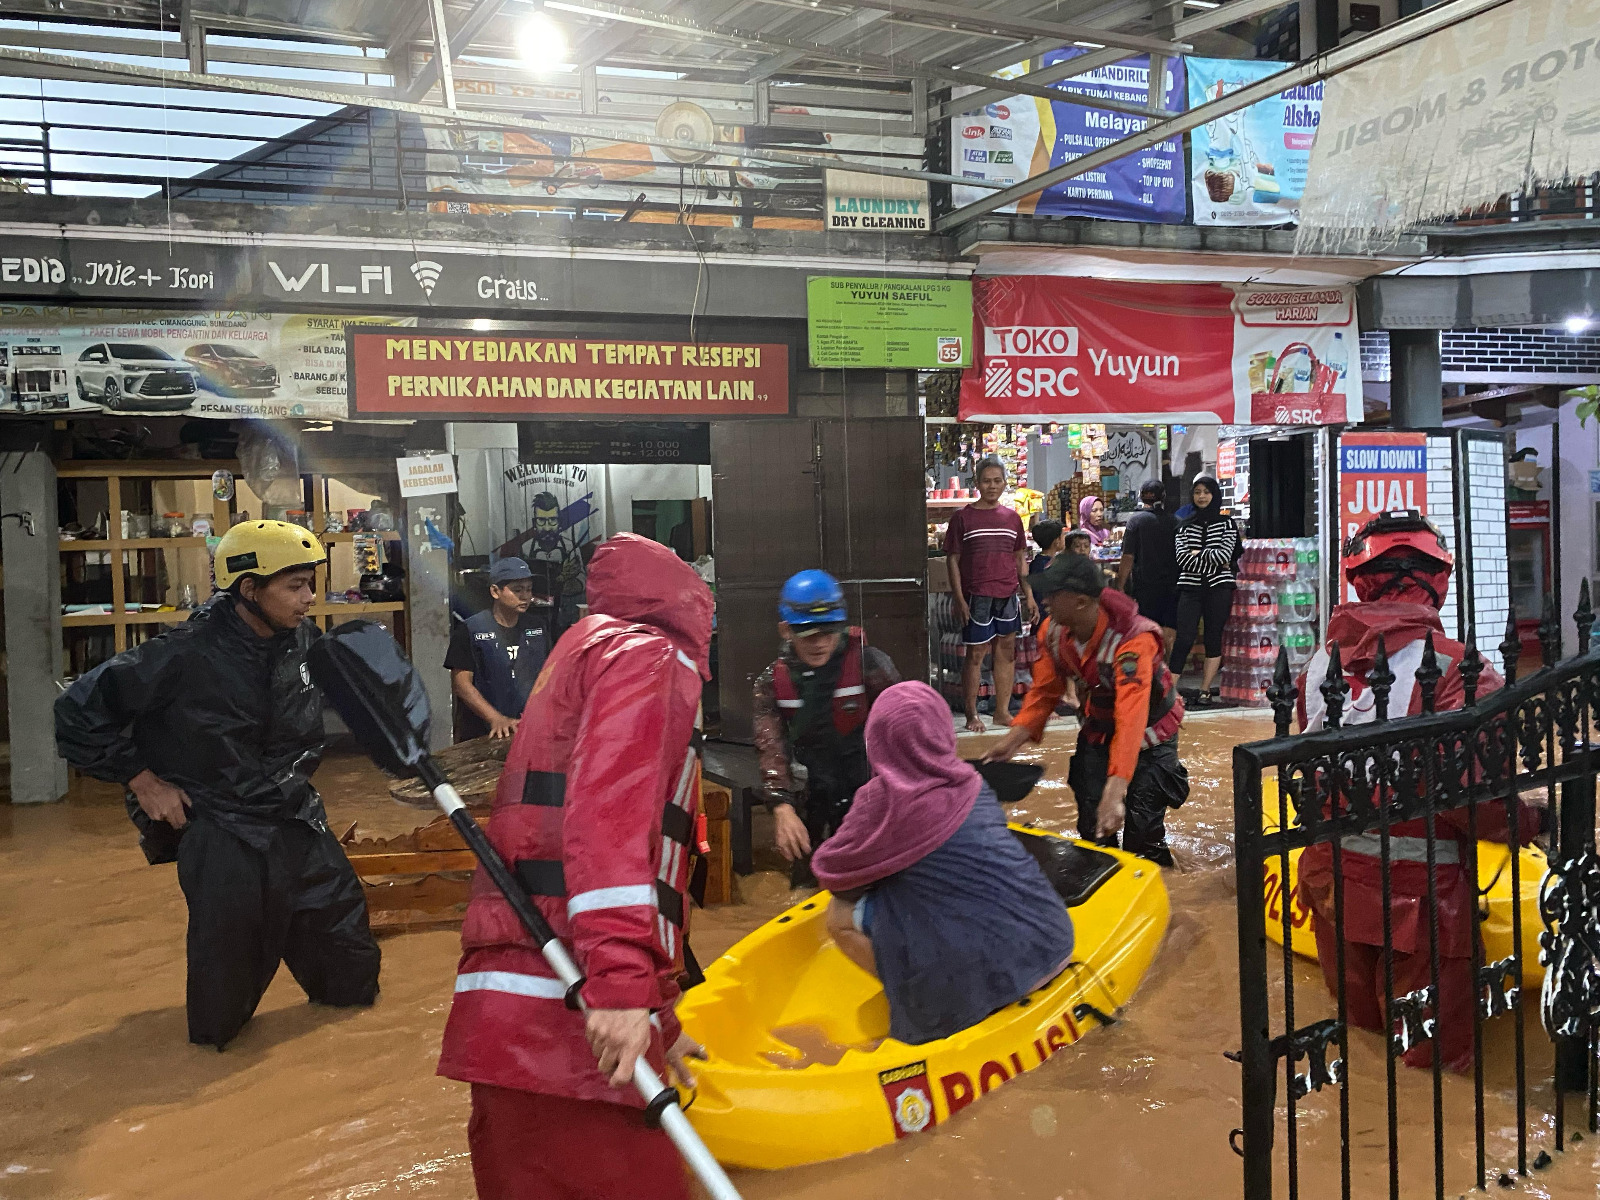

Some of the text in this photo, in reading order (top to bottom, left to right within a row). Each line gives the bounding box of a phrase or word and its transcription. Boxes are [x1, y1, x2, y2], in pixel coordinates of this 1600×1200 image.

[1085, 88, 1112, 99] TUNAI
[1084, 136, 1093, 147] ALL
[1085, 172, 1107, 183] LISTRIK
[1143, 175, 1174, 188] TOP UP OVO
[835, 197, 921, 214] LAUNDRY
[832, 215, 925, 229] DRY CLEANING
[169, 266, 214, 290] Kopi
[831, 281, 844, 289] SUB
[846, 282, 879, 290] PENYALUR
[884, 283, 921, 291] PANGKALAN
[923, 284, 936, 292] LPG
[851, 290, 932, 301] YUYUN SAEFUL
[1246, 292, 1289, 306] SOLUSI
[1276, 306, 1318, 321] HARIAN
[210, 320, 247, 328] SUMEDANG
[307, 318, 339, 328] SYARAT
[90, 328, 115, 337] PAKET
[117, 328, 139, 338] SEWA
[141, 329, 165, 338] MOBIL
[167, 329, 209, 340] PENGANTIN
[211, 330, 227, 340] DAN
[229, 330, 268, 341] KELUARGA
[993, 329, 1069, 354] TOKO
[304, 346, 321, 354] BILA
[386, 338, 761, 368] MENYEDIAKAN TEMPAT RESEPSI
[1088, 348, 1179, 383] Yuyun
[294, 372, 327, 381] BARANG
[330, 373, 337, 381] DI
[1016, 367, 1080, 398] SRC
[388, 375, 542, 398] PERNIKAHAN
[547, 376, 591, 399] DAN
[595, 378, 701, 401] KEGIATAN
[235, 405, 287, 416] SEKARANG
[1292, 409, 1322, 425] SRC
[1346, 449, 1379, 469] SLOW
[1381, 449, 1415, 469] DOWN
[408, 463, 444, 475] JAGALAH
[504, 463, 587, 483] WELCOME TO
[403, 474, 453, 488] KEBERSIHAN
[1347, 480, 1421, 514] JUAL
